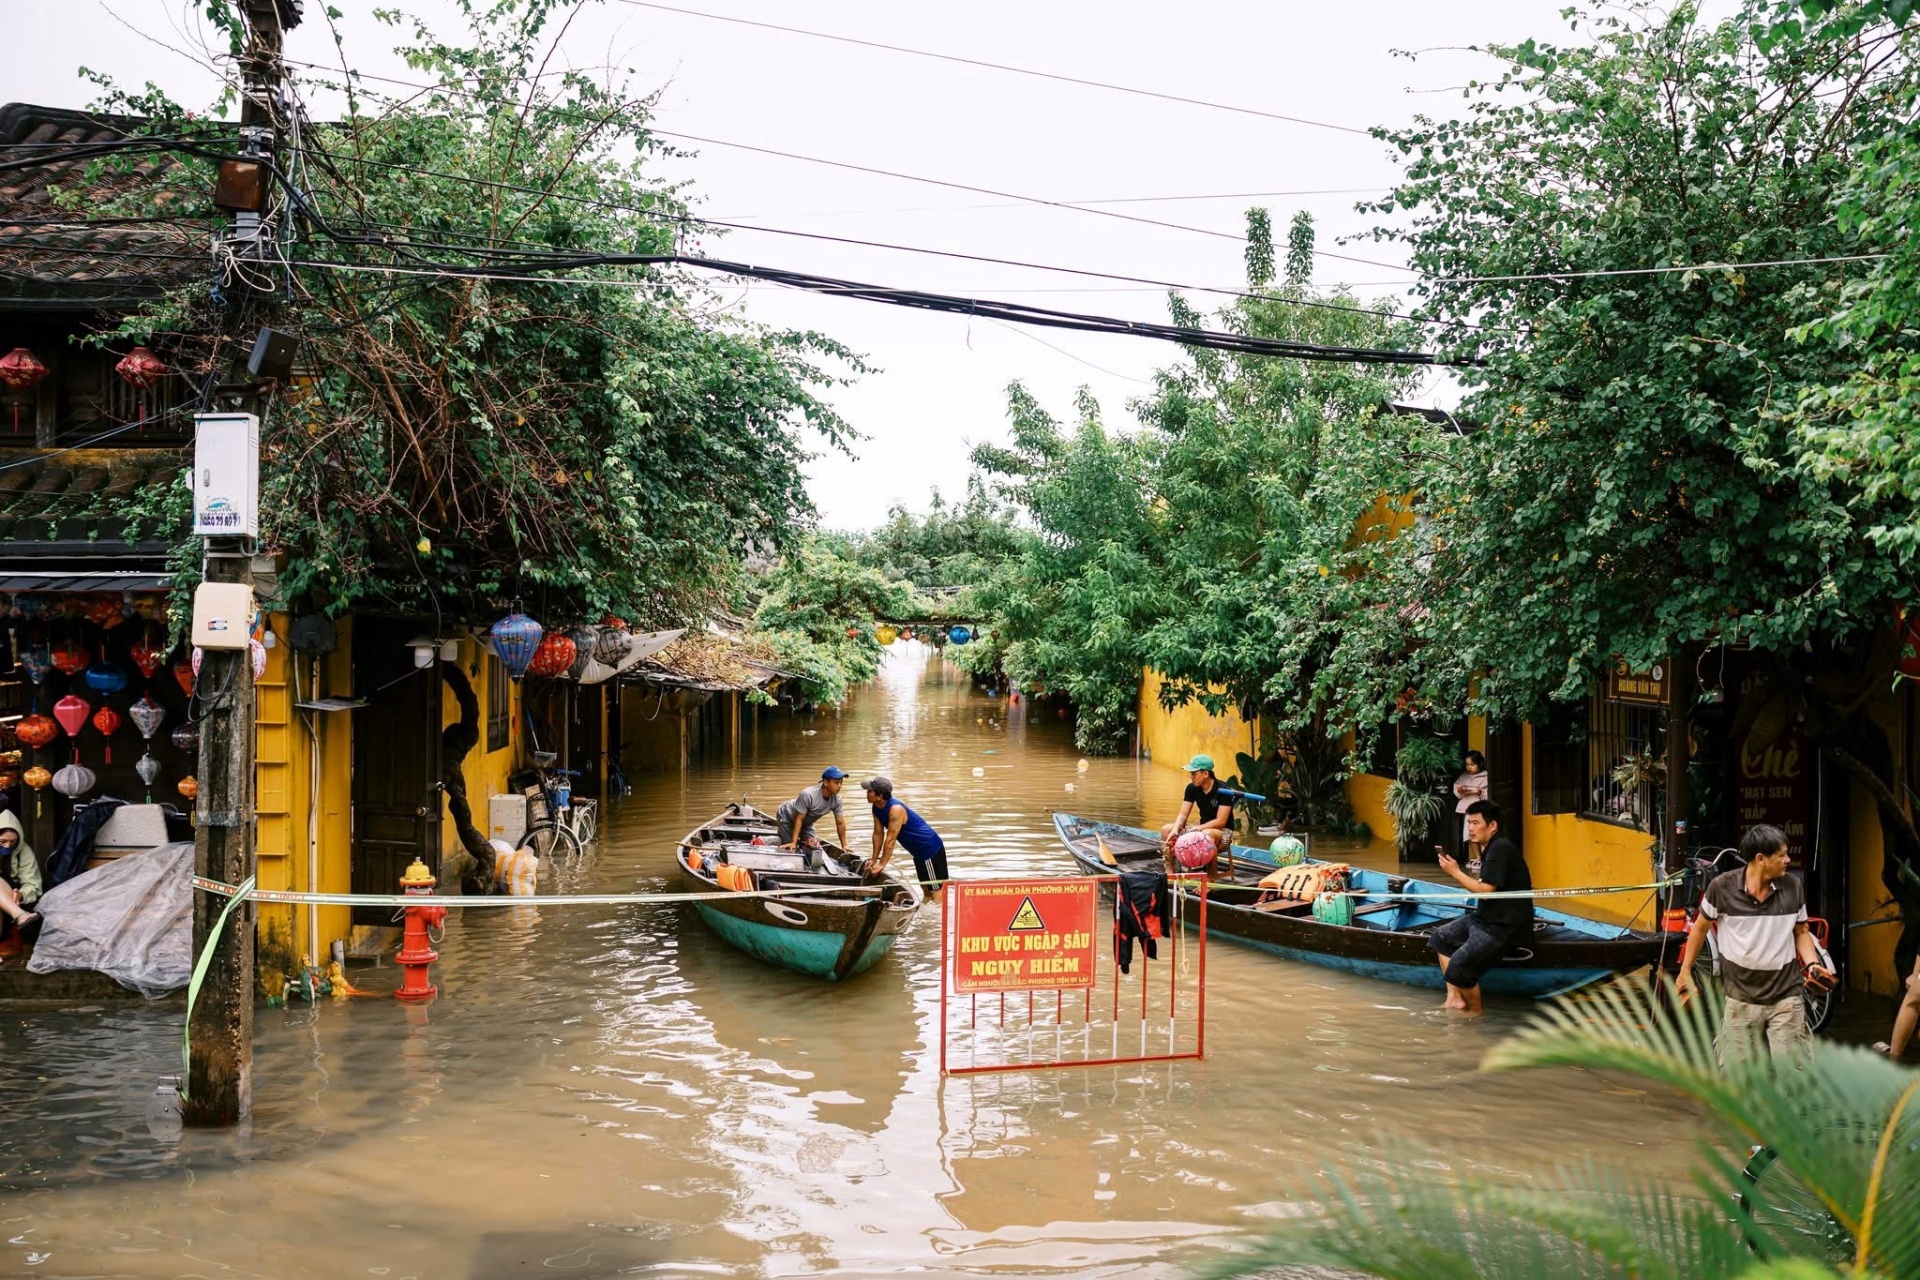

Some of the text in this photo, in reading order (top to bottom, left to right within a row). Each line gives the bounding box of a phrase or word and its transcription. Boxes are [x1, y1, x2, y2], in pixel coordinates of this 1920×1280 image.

[1769, 786, 1794, 799] SEN
[976, 887, 991, 896] BAN
[992, 886, 1013, 895] NHÂN
[1015, 885, 1031, 894] DÂN
[1032, 885, 1062, 894] PHƯỜNG
[1079, 885, 1090, 893] AN
[961, 929, 1090, 955] KHU VỰC NGẬP SÂU
[971, 951, 1080, 976] NGUY HIỂM
